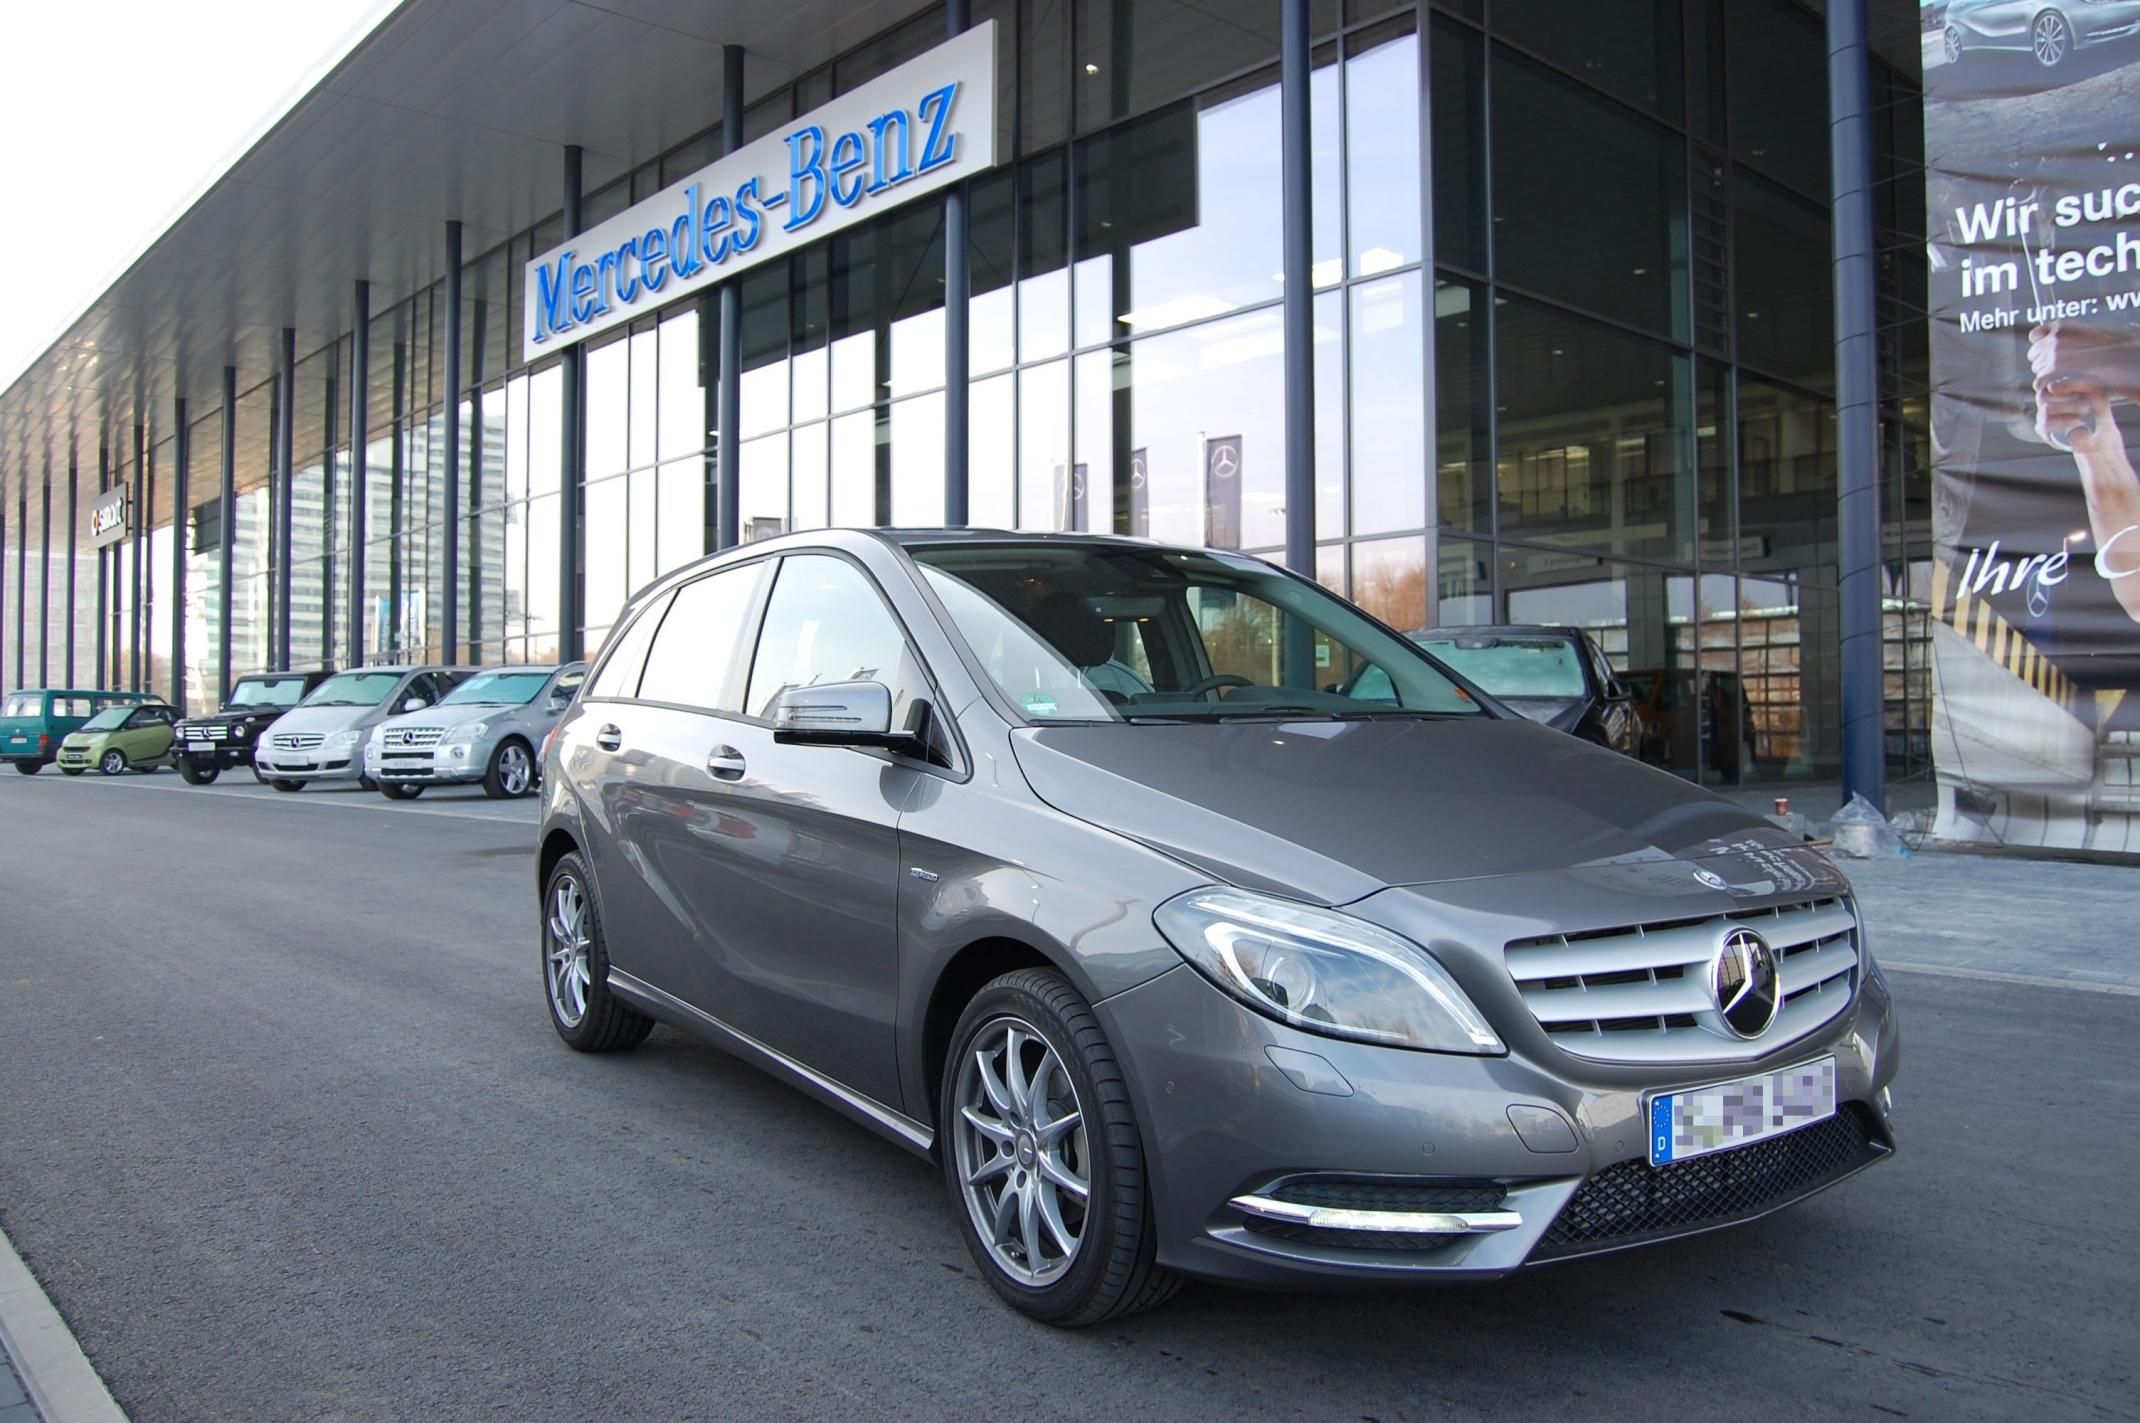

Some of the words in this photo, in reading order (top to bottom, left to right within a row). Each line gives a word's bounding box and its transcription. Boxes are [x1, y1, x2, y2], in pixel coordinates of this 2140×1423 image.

[532, 80, 963, 343] Mercedes-Benz
[1955, 197, 2039, 245] Wir
[2055, 183, 2140, 227] suc
[1961, 258, 2018, 298] im
[2035, 231, 2140, 286] tech
[1959, 308, 2020, 334] Mehr
[2027, 298, 2099, 324] unter:
[99, 497, 122, 533] smart
[1956, 540, 2069, 600] Ihre
[1657, 1136, 1666, 1151] D
